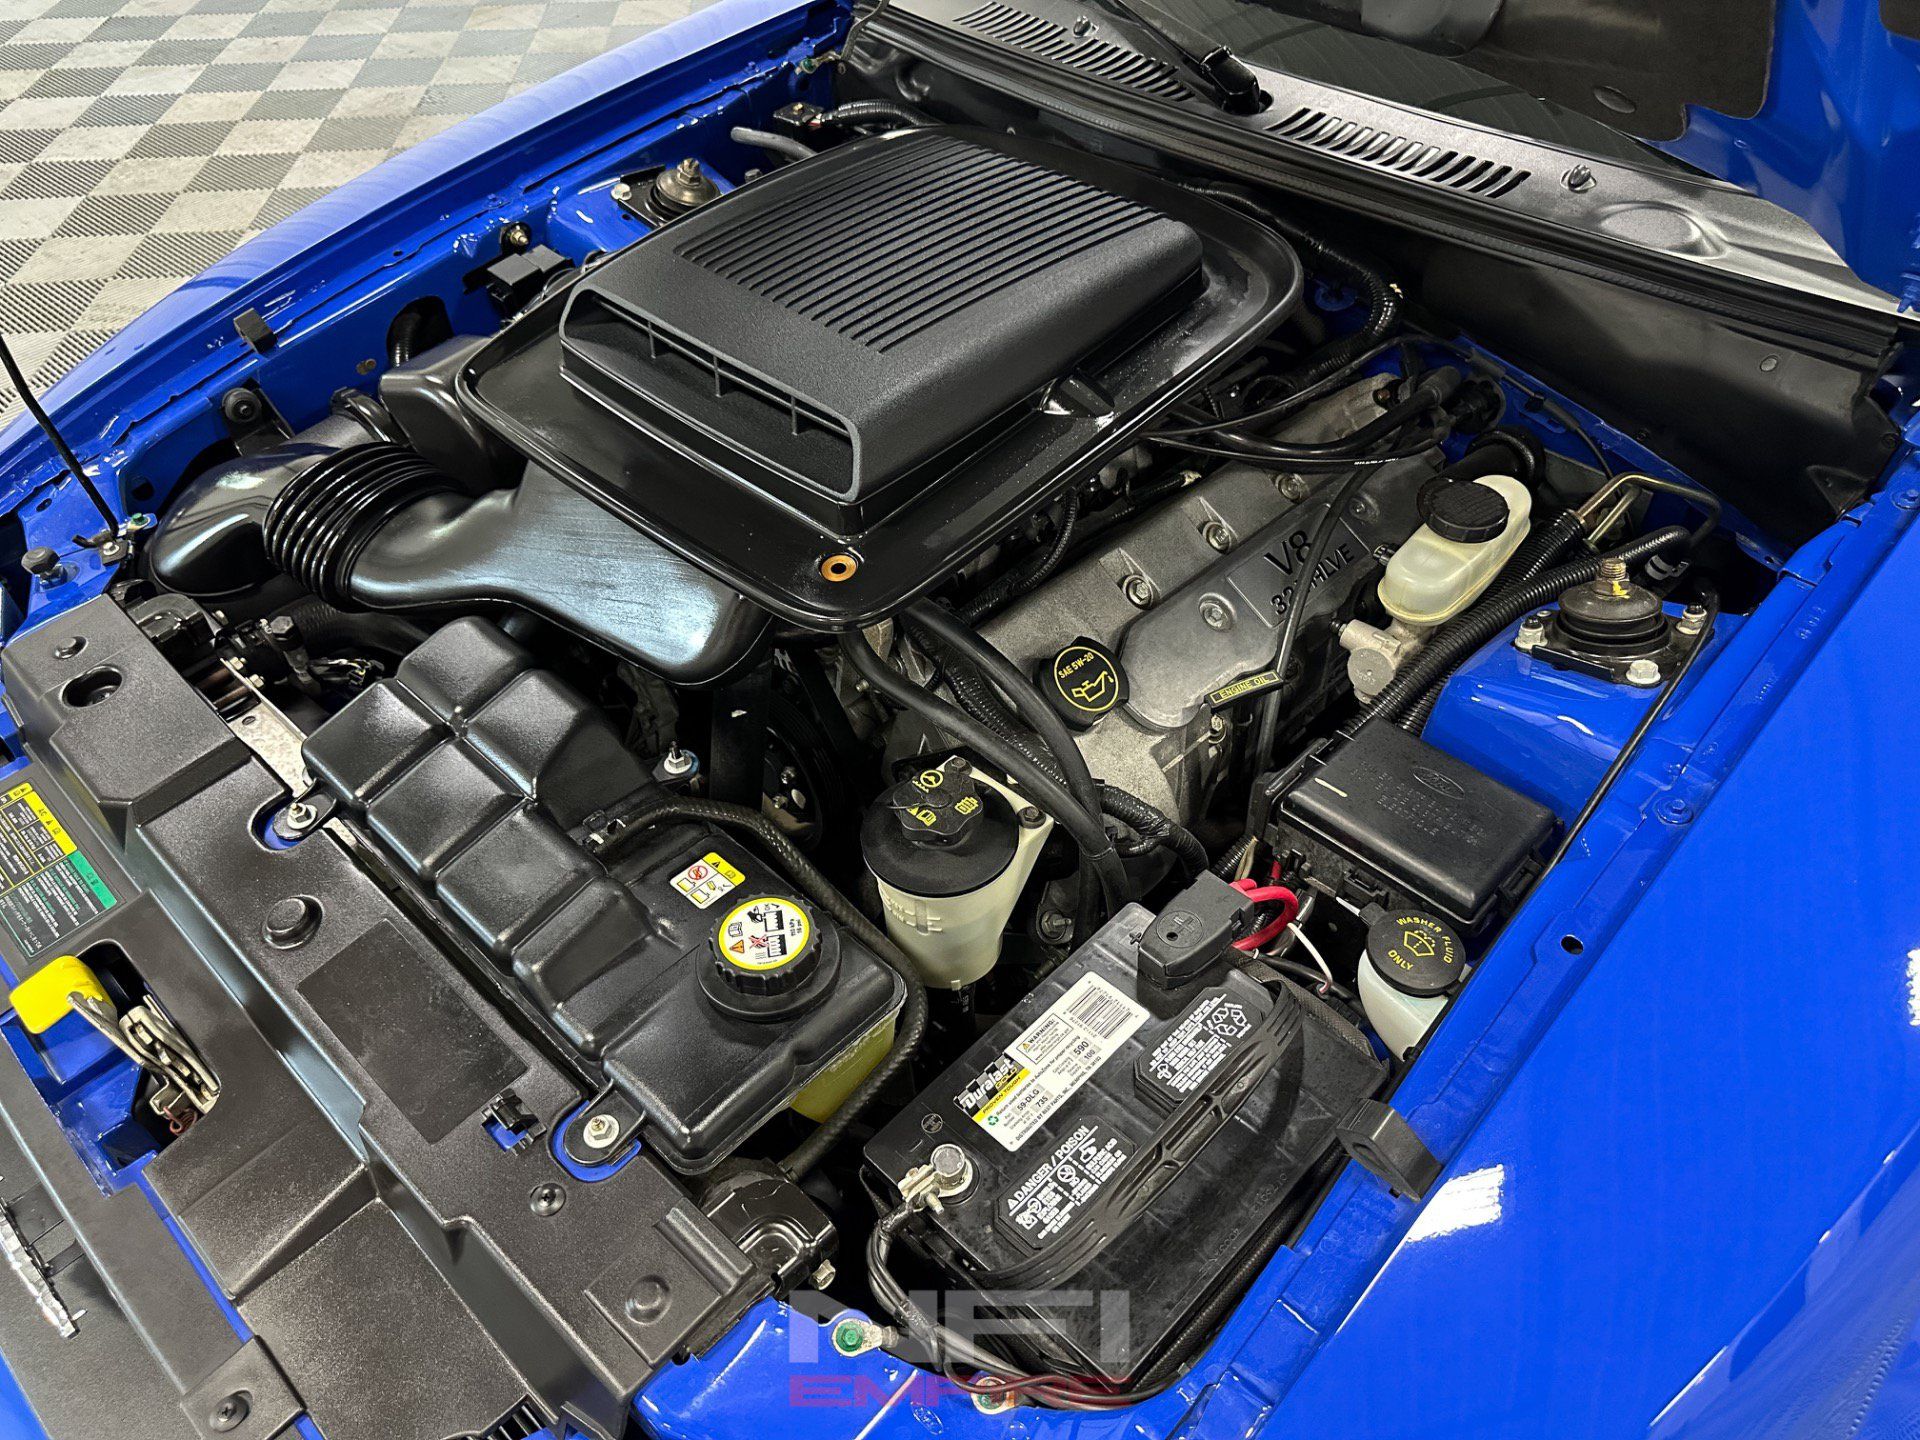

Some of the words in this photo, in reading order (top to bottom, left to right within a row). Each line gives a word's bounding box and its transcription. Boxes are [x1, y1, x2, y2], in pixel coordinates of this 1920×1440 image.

[1264, 530, 1312, 576] V8
[1294, 543, 1355, 590] ALVE
[1058, 665, 1074, 679] SAE
[1071, 652, 1094, 670] 5W-20
[1219, 681, 1252, 699] ENGINE
[1253, 676, 1269, 686] OIL
[1396, 917, 1442, 933] WASHER
[1441, 936, 1454, 964] FLUID
[1388, 949, 1414, 970] ONLY
[1072, 1040, 1089, 1055] 590
[1083, 1048, 1096, 1060] 100
[958, 1057, 1015, 1110] Duralast
[993, 1065, 1018, 1089] GOLD
[981, 1093, 1003, 1113] PROVEN
[1002, 1076, 1021, 1093] TOUGH
[1016, 1088, 1040, 1111] 59-DLG
[1034, 1094, 1048, 1108] 735
[1012, 1161, 1053, 1201] DANGER
[1053, 1124, 1090, 1160] POISON
